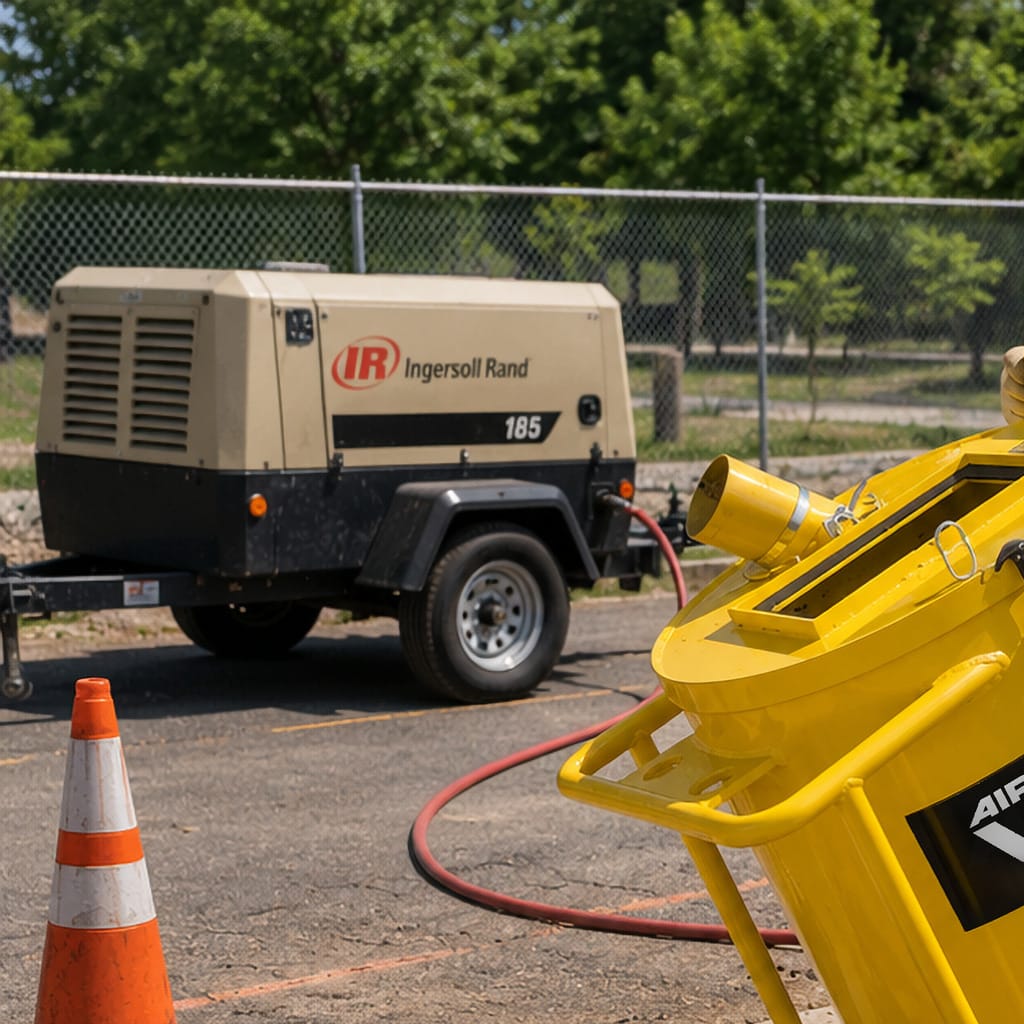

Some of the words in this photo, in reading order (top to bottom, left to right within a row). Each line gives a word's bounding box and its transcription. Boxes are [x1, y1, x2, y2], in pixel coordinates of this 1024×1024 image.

[344, 344, 388, 380] IR
[404, 357, 482, 384] Ingersoll
[485, 357, 529, 378] Rand
[505, 415, 542, 440] 185
